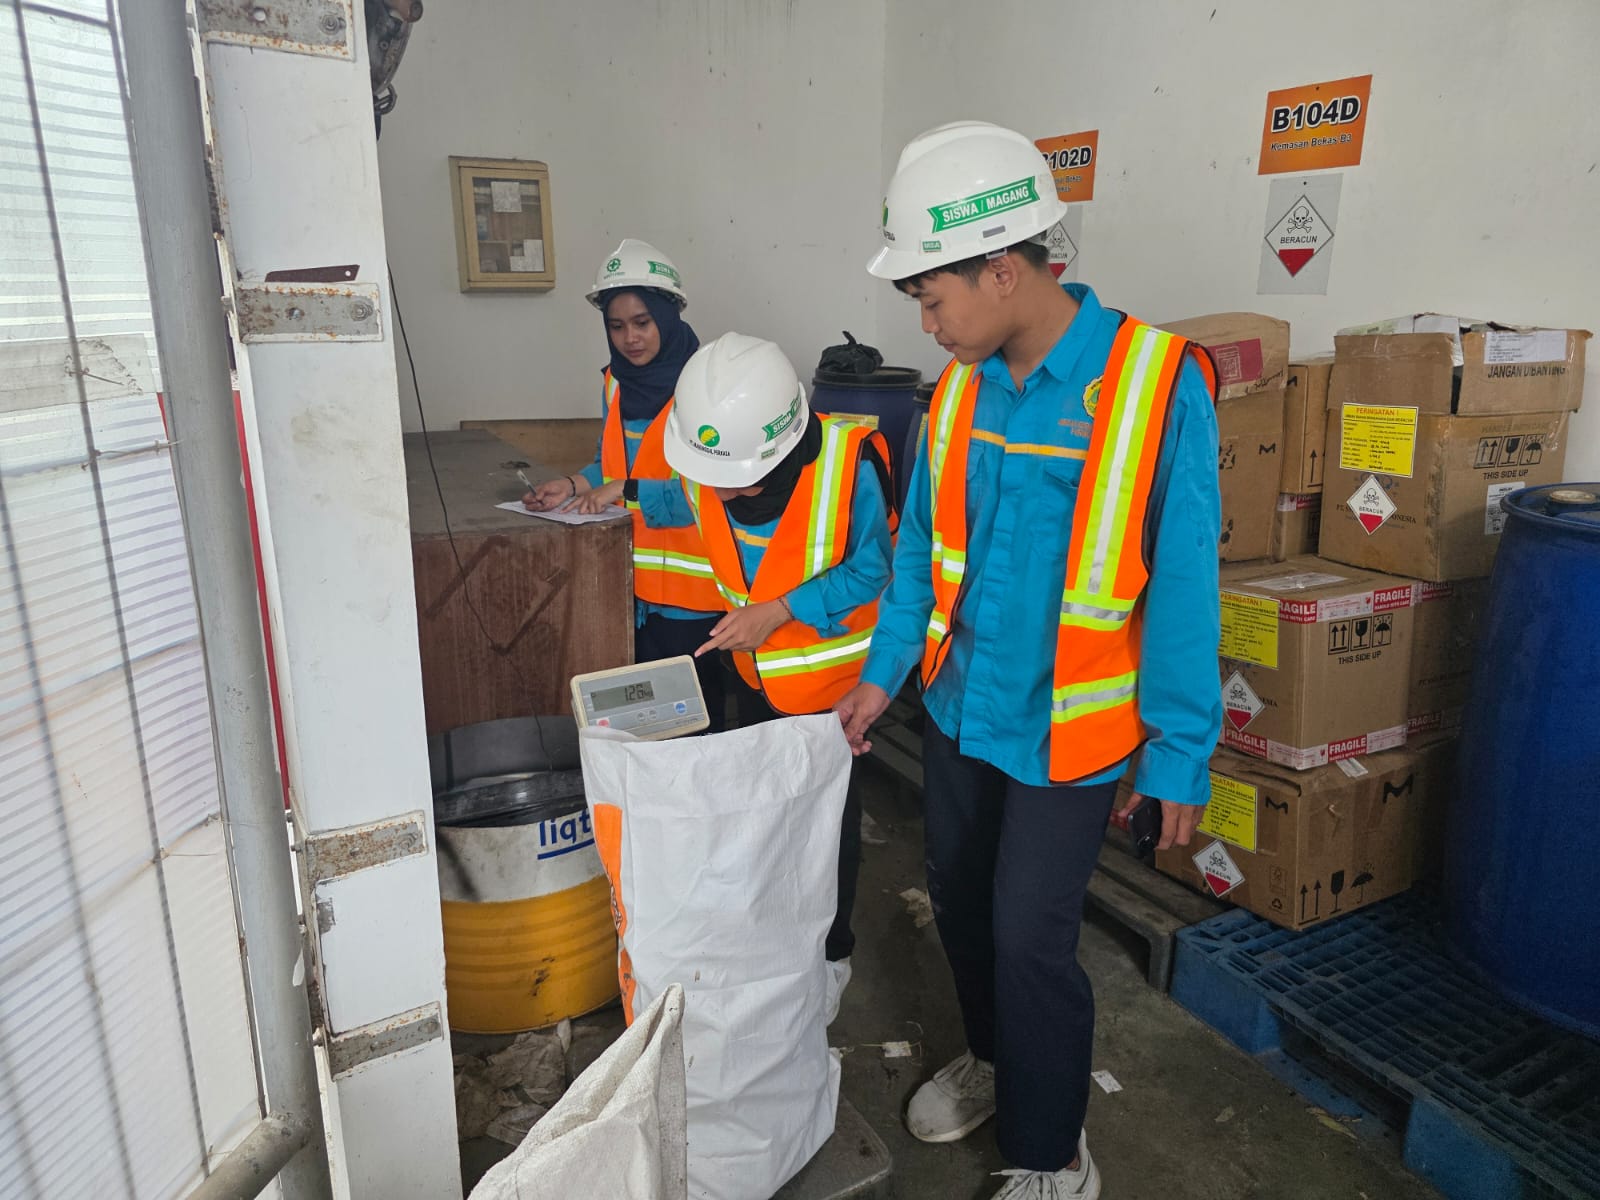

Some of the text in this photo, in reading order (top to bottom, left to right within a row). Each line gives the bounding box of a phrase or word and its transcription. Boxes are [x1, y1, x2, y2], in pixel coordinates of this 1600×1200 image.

[1271, 96, 1361, 133] B104D
[1271, 133, 1353, 152] Kemasan Bekas B3
[942, 204, 979, 223] SISWA
[986, 185, 1030, 210] MAGANG
[1280, 235, 1318, 244] BERACUN
[1488, 364, 1521, 378] JANGAN
[1356, 407, 1395, 416] PERINGATAN
[1483, 469, 1529, 480] THIS SIDE UP
[1359, 506, 1383, 514] BERACUN
[1375, 589, 1410, 603] FRAGILE
[1338, 650, 1382, 665] THIS SIDE UP
[1226, 702, 1252, 711] BERACUN
[1407, 712, 1440, 728] FRAGILE
[1226, 729, 1266, 750] FRAGILE
[1329, 737, 1366, 754] FRAGILE
